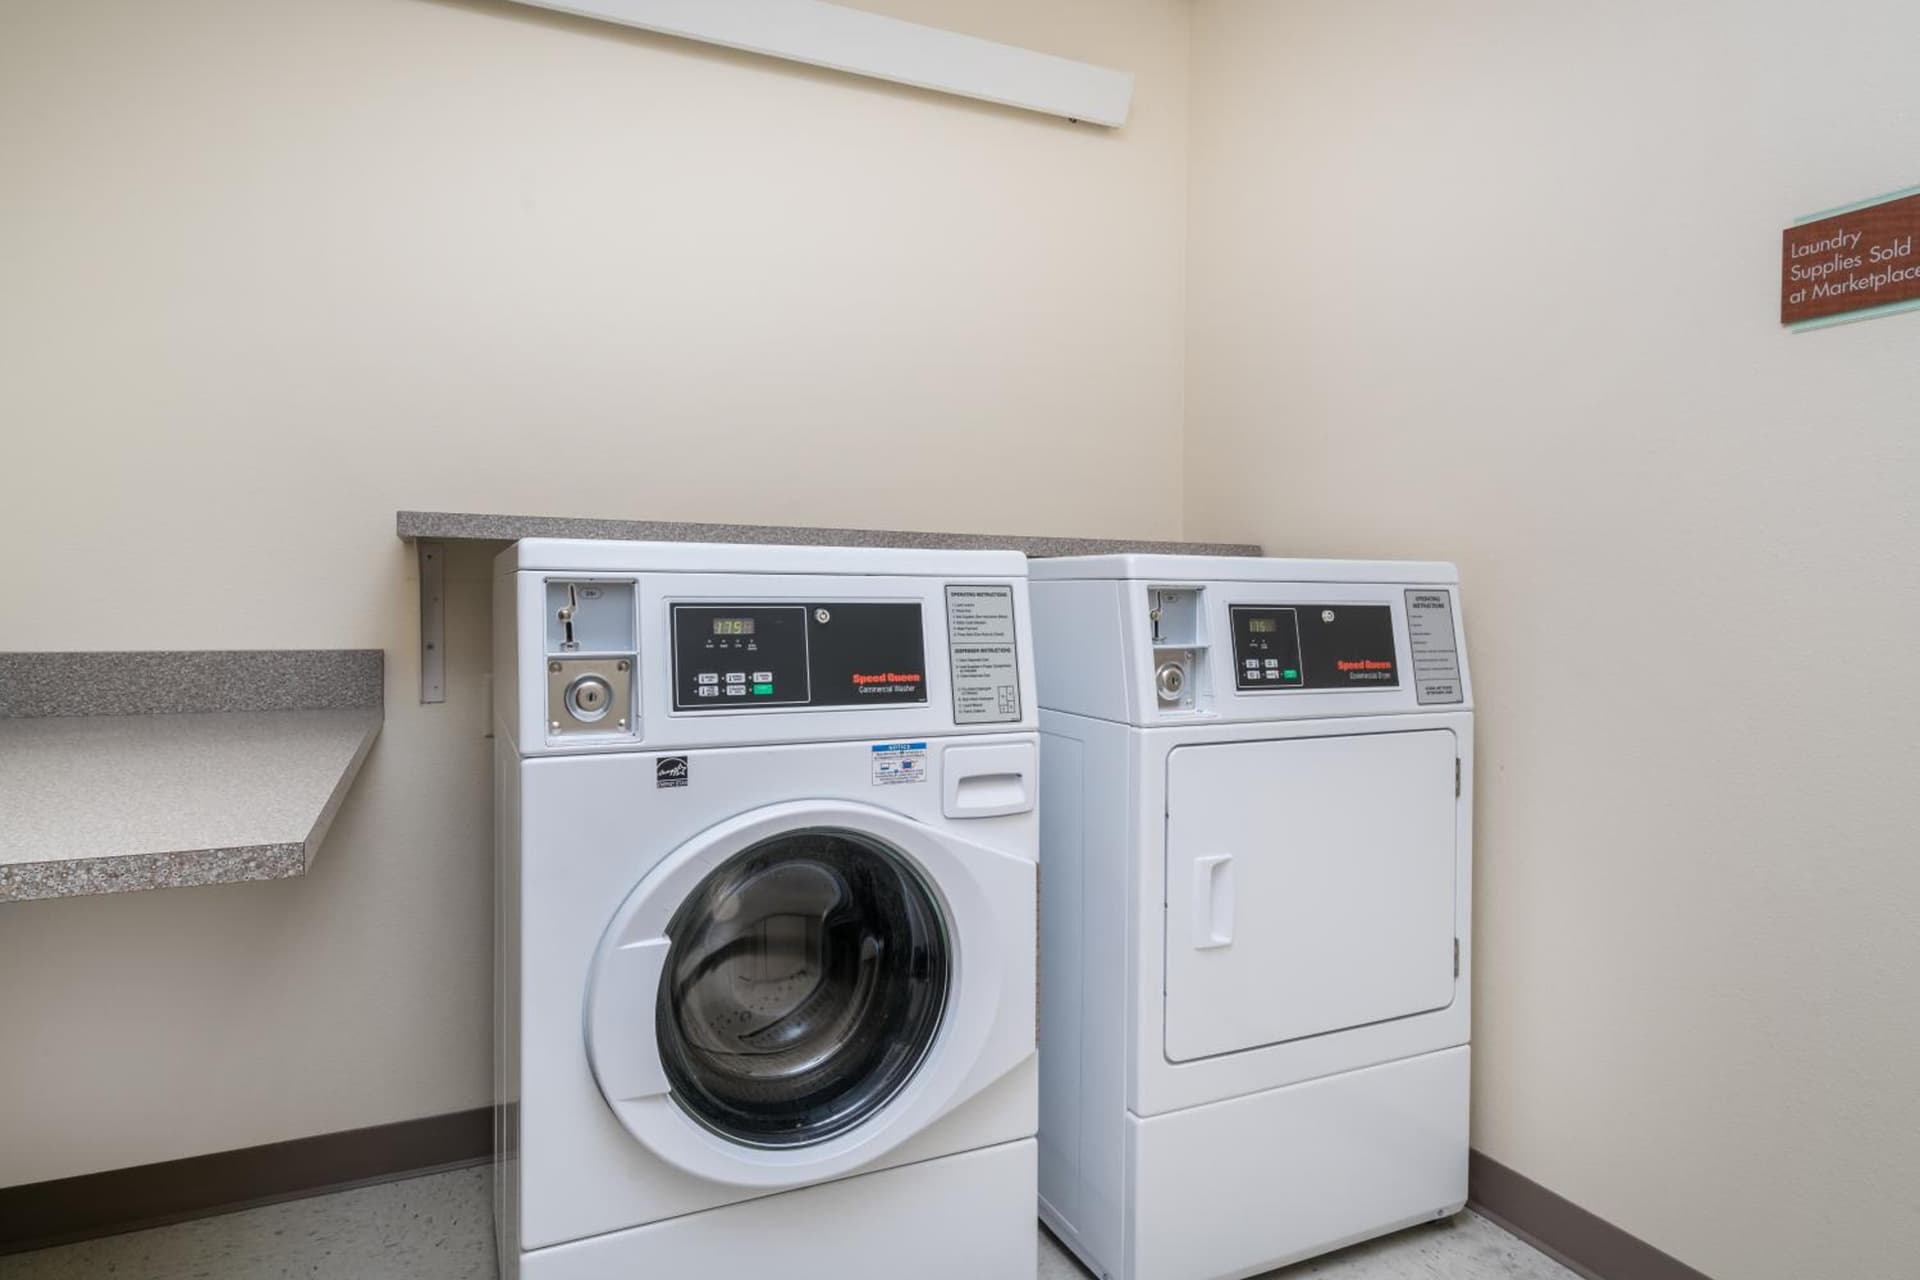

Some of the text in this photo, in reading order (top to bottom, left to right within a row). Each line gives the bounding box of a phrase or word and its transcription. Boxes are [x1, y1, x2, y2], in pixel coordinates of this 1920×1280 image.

[1791, 229, 1862, 259] Laundry
[1791, 236, 1912, 281] Supplies Sold
[1790, 289, 1807, 304] at
[1337, 660, 1392, 671] Speed Queen
[853, 673, 920, 684] Speed Queen
